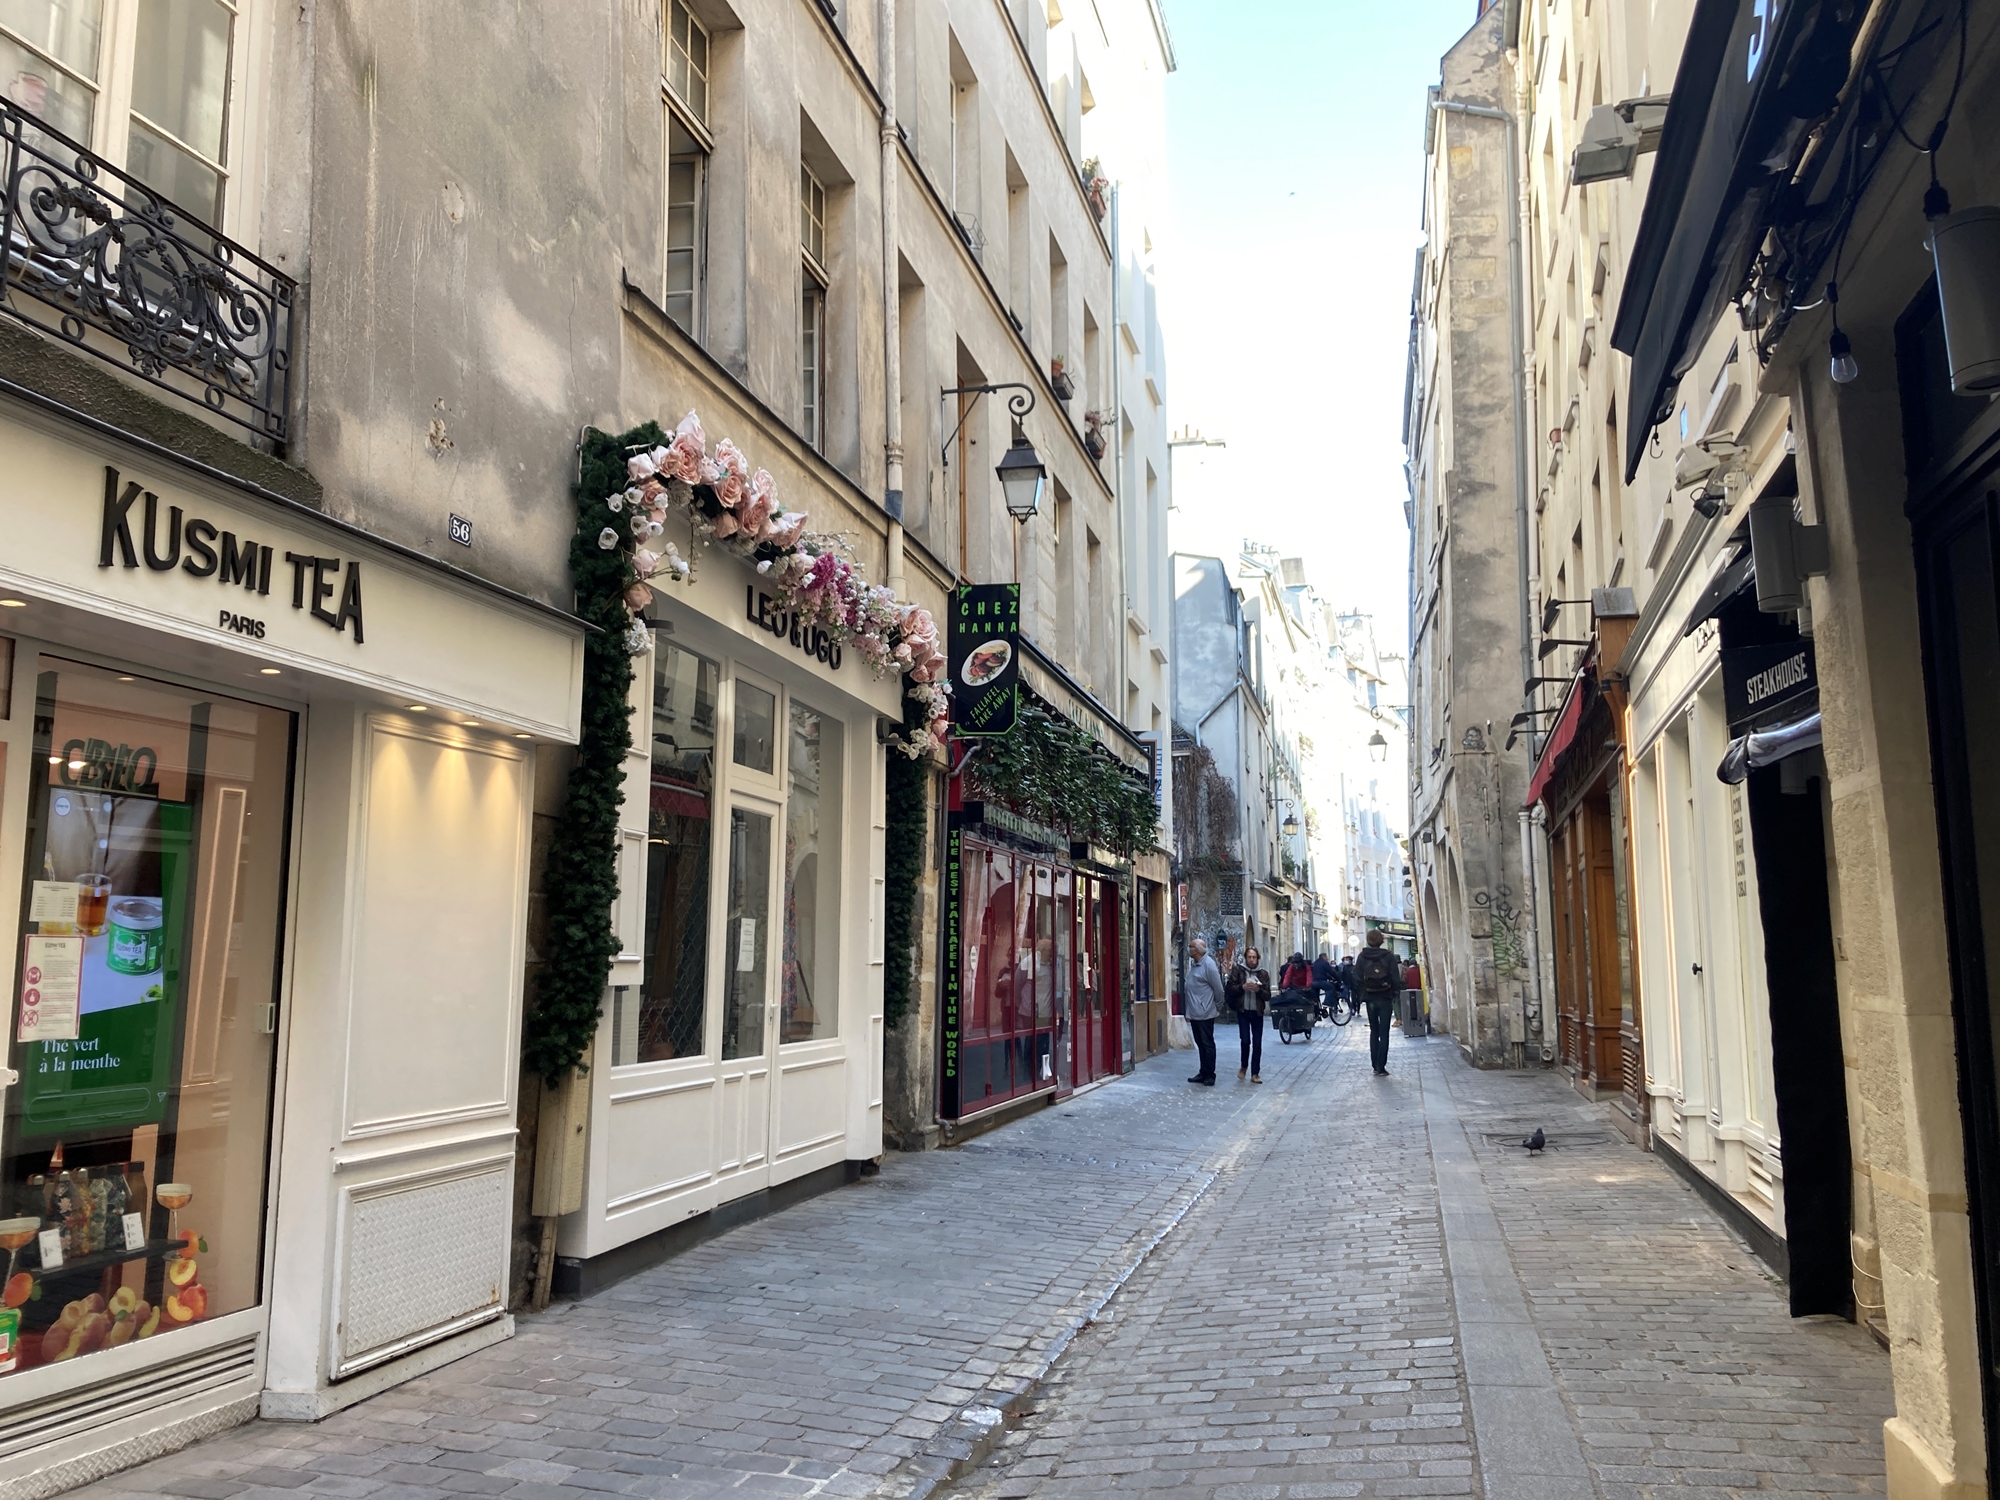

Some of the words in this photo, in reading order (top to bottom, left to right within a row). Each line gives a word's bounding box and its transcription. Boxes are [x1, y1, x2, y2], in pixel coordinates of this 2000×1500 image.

[451, 518, 470, 542] 56
[98, 465, 274, 596] KUSMI
[286, 550, 365, 644] TEA
[961, 602, 1017, 615] CHEZ
[219, 609, 266, 639] PARIS
[747, 585, 787, 638] LEO
[790, 612, 801, 648] &
[803, 624, 842, 670] UGO
[959, 622, 1017, 633] HANNA
[1746, 652, 1808, 704] STEAKHOUSE
[970, 686, 1000, 718] FALLAFEL
[974, 707, 993, 728] TAKE
[992, 687, 1011, 710] AWAY
[950, 829, 960, 855] THE
[949, 861, 960, 895] BEST
[132, 946, 142, 954] TEA
[948, 901, 960, 969] FALLAFEL
[948, 972, 958, 991] IN
[947, 995, 958, 1025] THE
[74, 1037, 100, 1051] vert
[945, 1030, 959, 1077] WORLD
[39, 1058, 47, 1074] à
[53, 1056, 66, 1072] la
[71, 1053, 121, 1071] menthe
